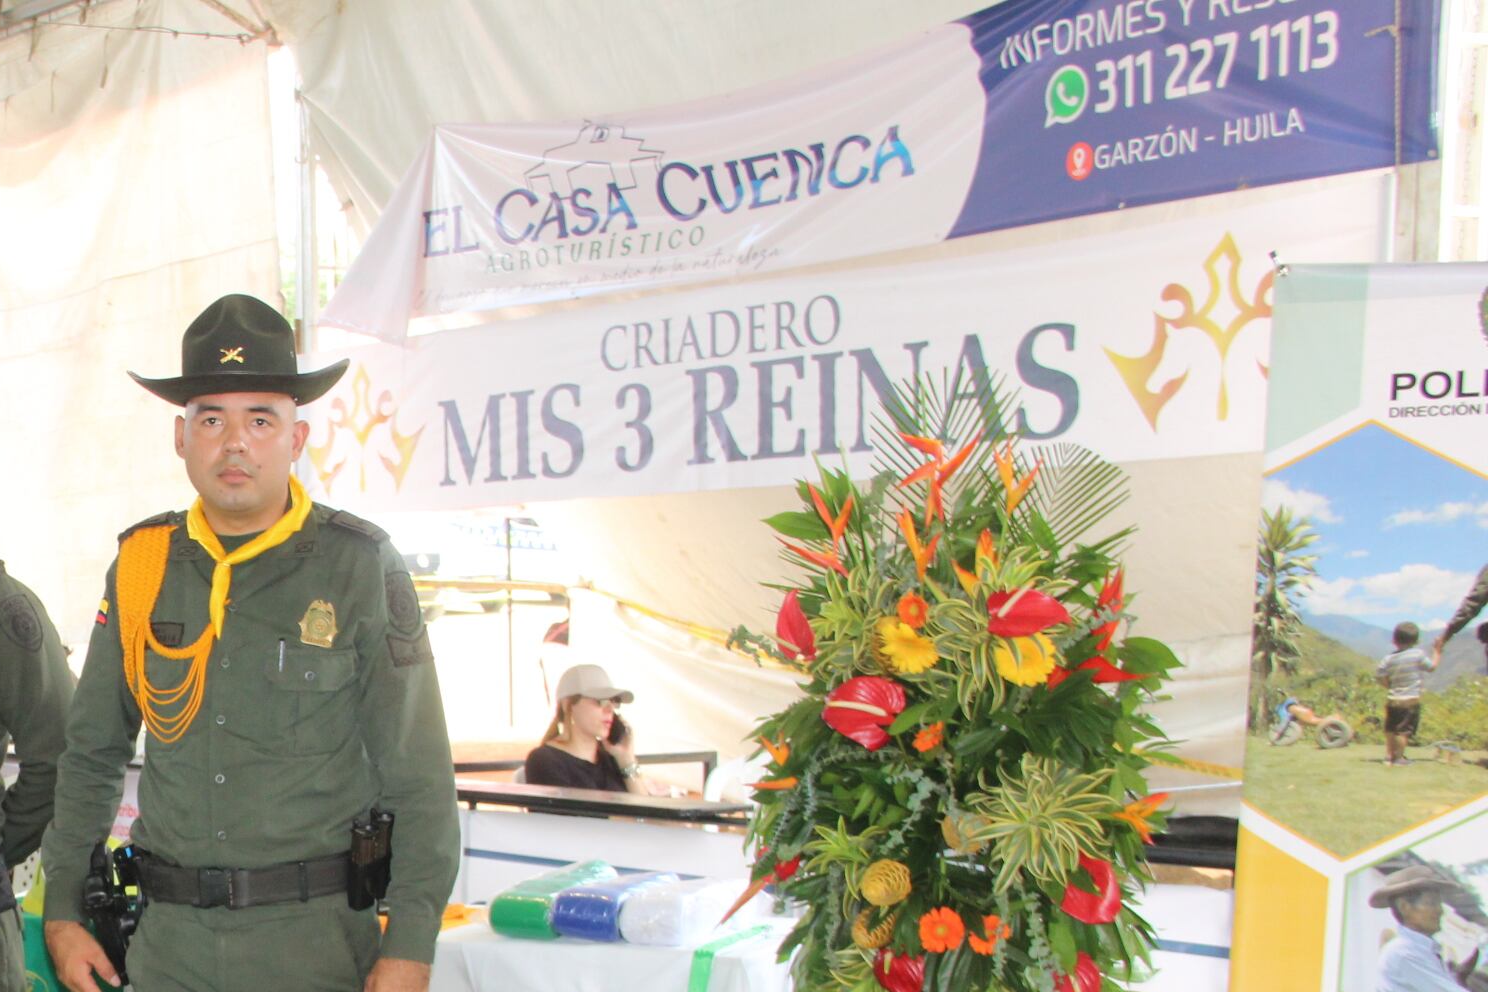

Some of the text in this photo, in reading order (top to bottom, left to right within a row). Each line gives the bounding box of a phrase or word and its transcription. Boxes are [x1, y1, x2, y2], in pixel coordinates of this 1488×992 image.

[1000, 0, 1167, 68] INFORMES
[1094, 10, 1339, 113] 311 227 1113
[1093, 125, 1198, 169] GARZÓN
[1223, 108, 1305, 146] HUILA
[494, 182, 639, 244] CASA
[656, 126, 916, 221] CUENCA
[484, 225, 707, 273] AGROTURÍSTICO
[600, 295, 841, 372] CRIADERO
[439, 323, 1079, 487] MIS 3 REINAS
[1389, 402, 1481, 418] DIRECCIÓN
